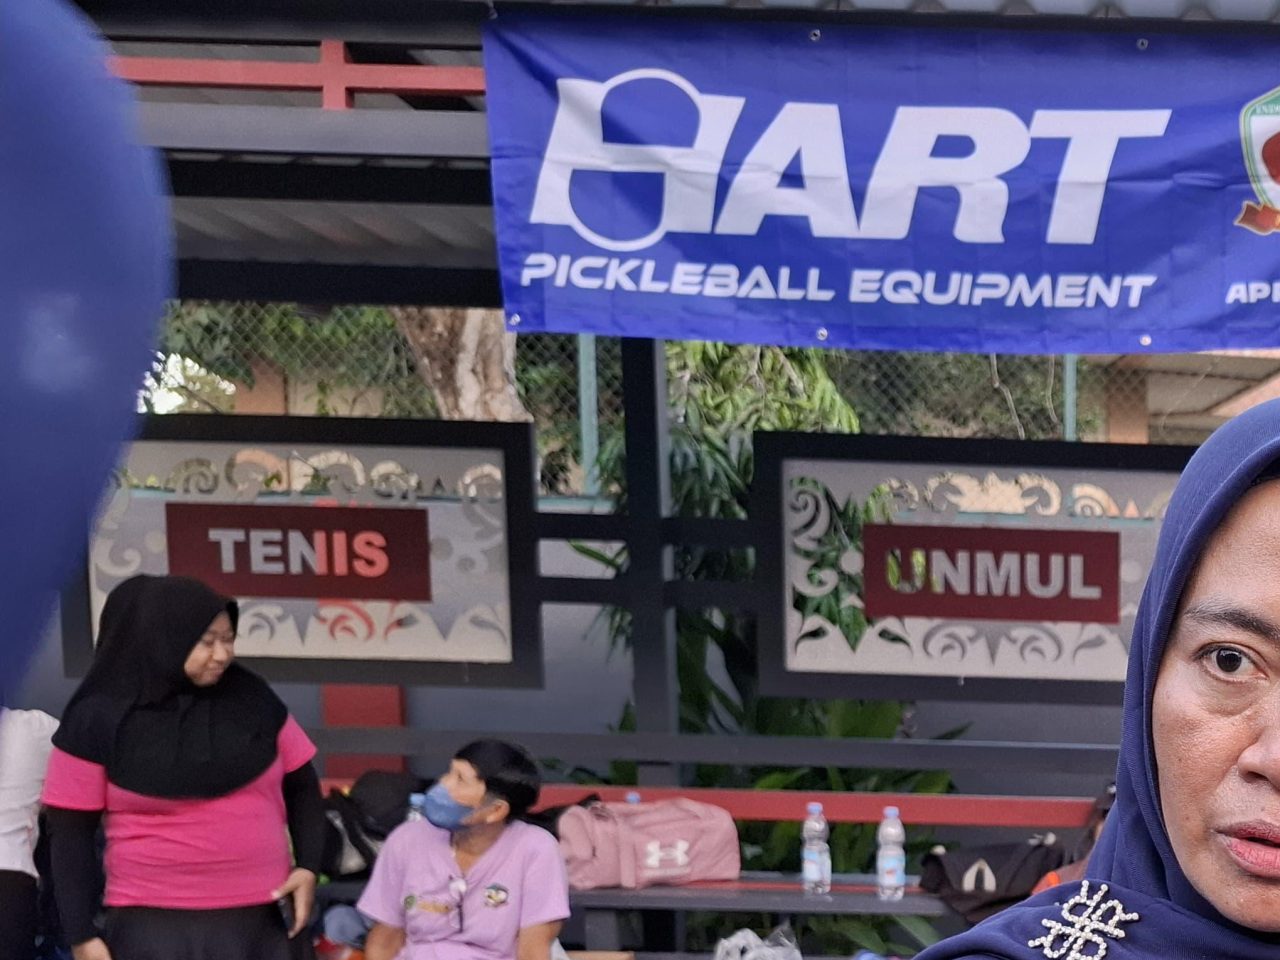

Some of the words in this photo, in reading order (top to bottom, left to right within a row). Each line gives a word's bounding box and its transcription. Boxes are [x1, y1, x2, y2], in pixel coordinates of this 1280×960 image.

[529, 67, 1171, 251] HART
[521, 253, 835, 302] PICKLEBALL
[847, 268, 1158, 308] EQUIPMENT
[208, 528, 390, 579] TENIS
[886, 547, 1102, 600] UNMUL
